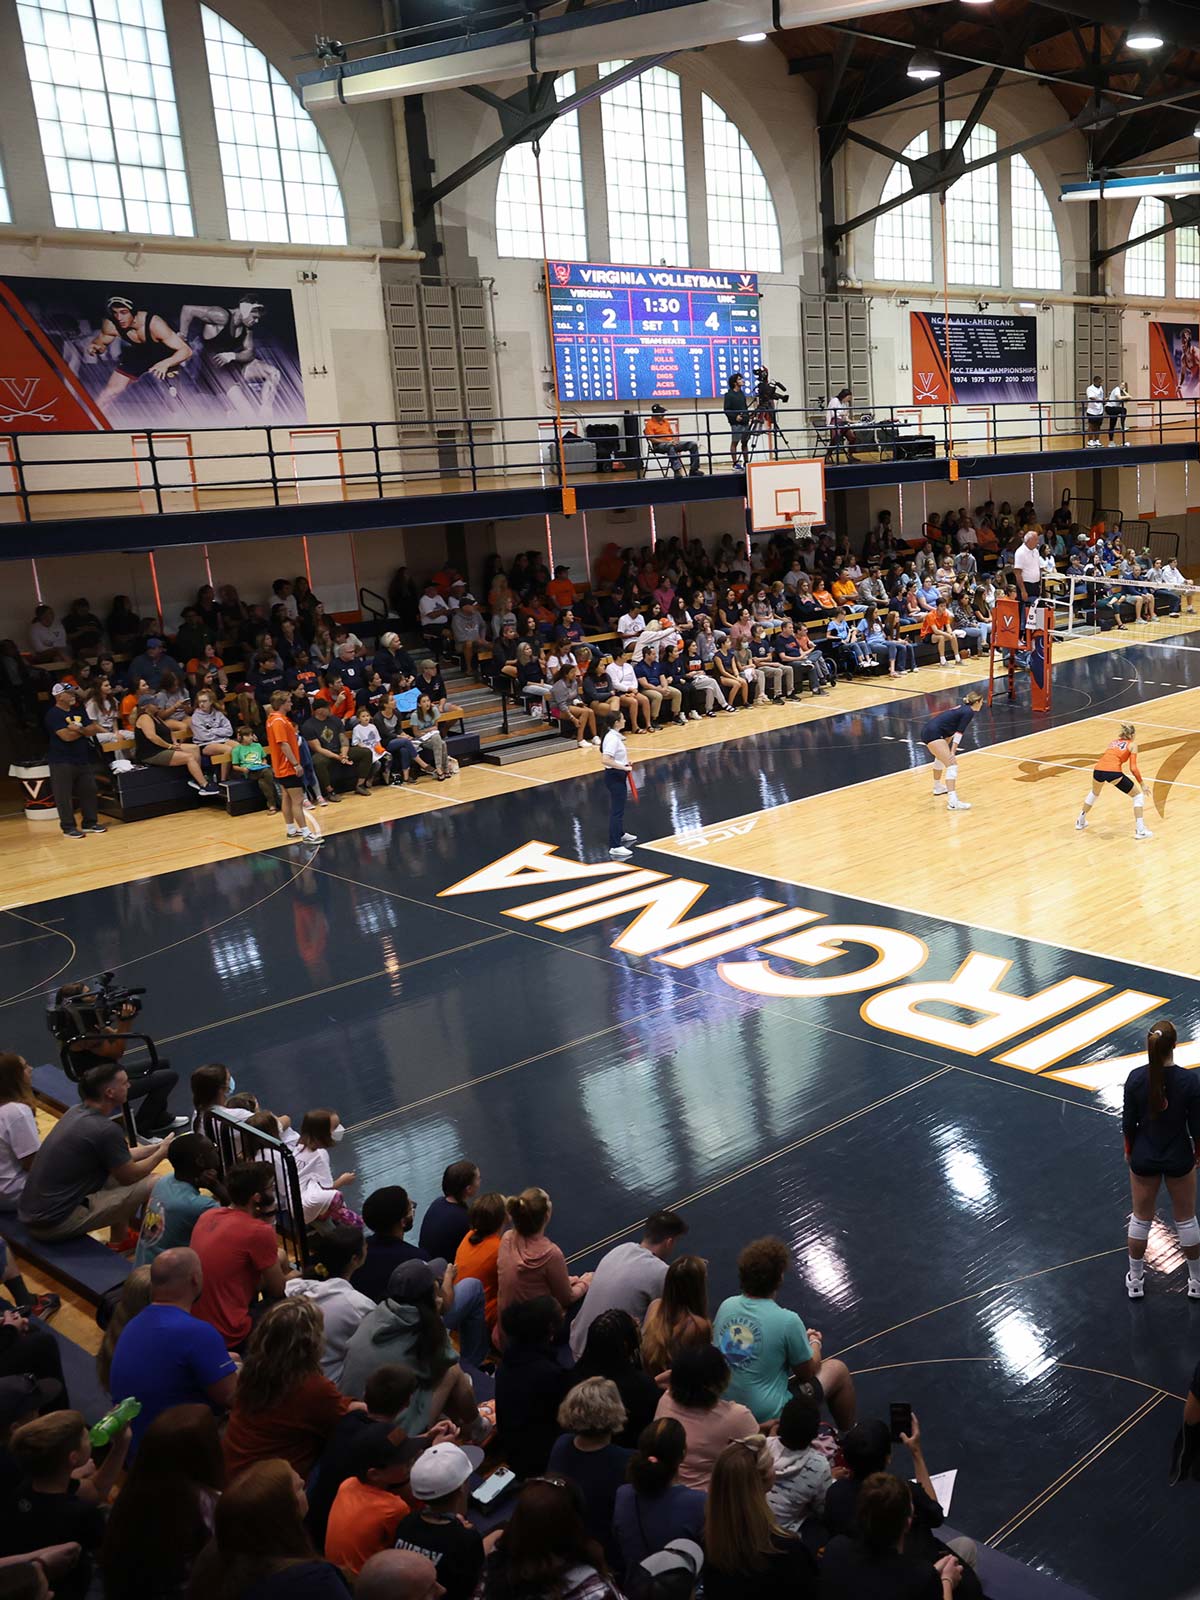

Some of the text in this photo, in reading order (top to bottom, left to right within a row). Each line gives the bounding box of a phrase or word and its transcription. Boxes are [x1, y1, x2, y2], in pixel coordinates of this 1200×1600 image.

[580, 270, 732, 289] VIRGINIA VOLLEYBALL
[570, 289, 613, 299] VIRGINIA
[717, 295, 736, 303] UNC
[643, 298, 680, 314] 1:30
[602, 308, 617, 329] 2
[705, 312, 720, 331] 4
[956, 318, 1014, 326] ALL-AMERICANS
[578, 322, 584, 330] 2
[643, 320, 678, 332] SET 1
[675, 817, 759, 850] ACC
